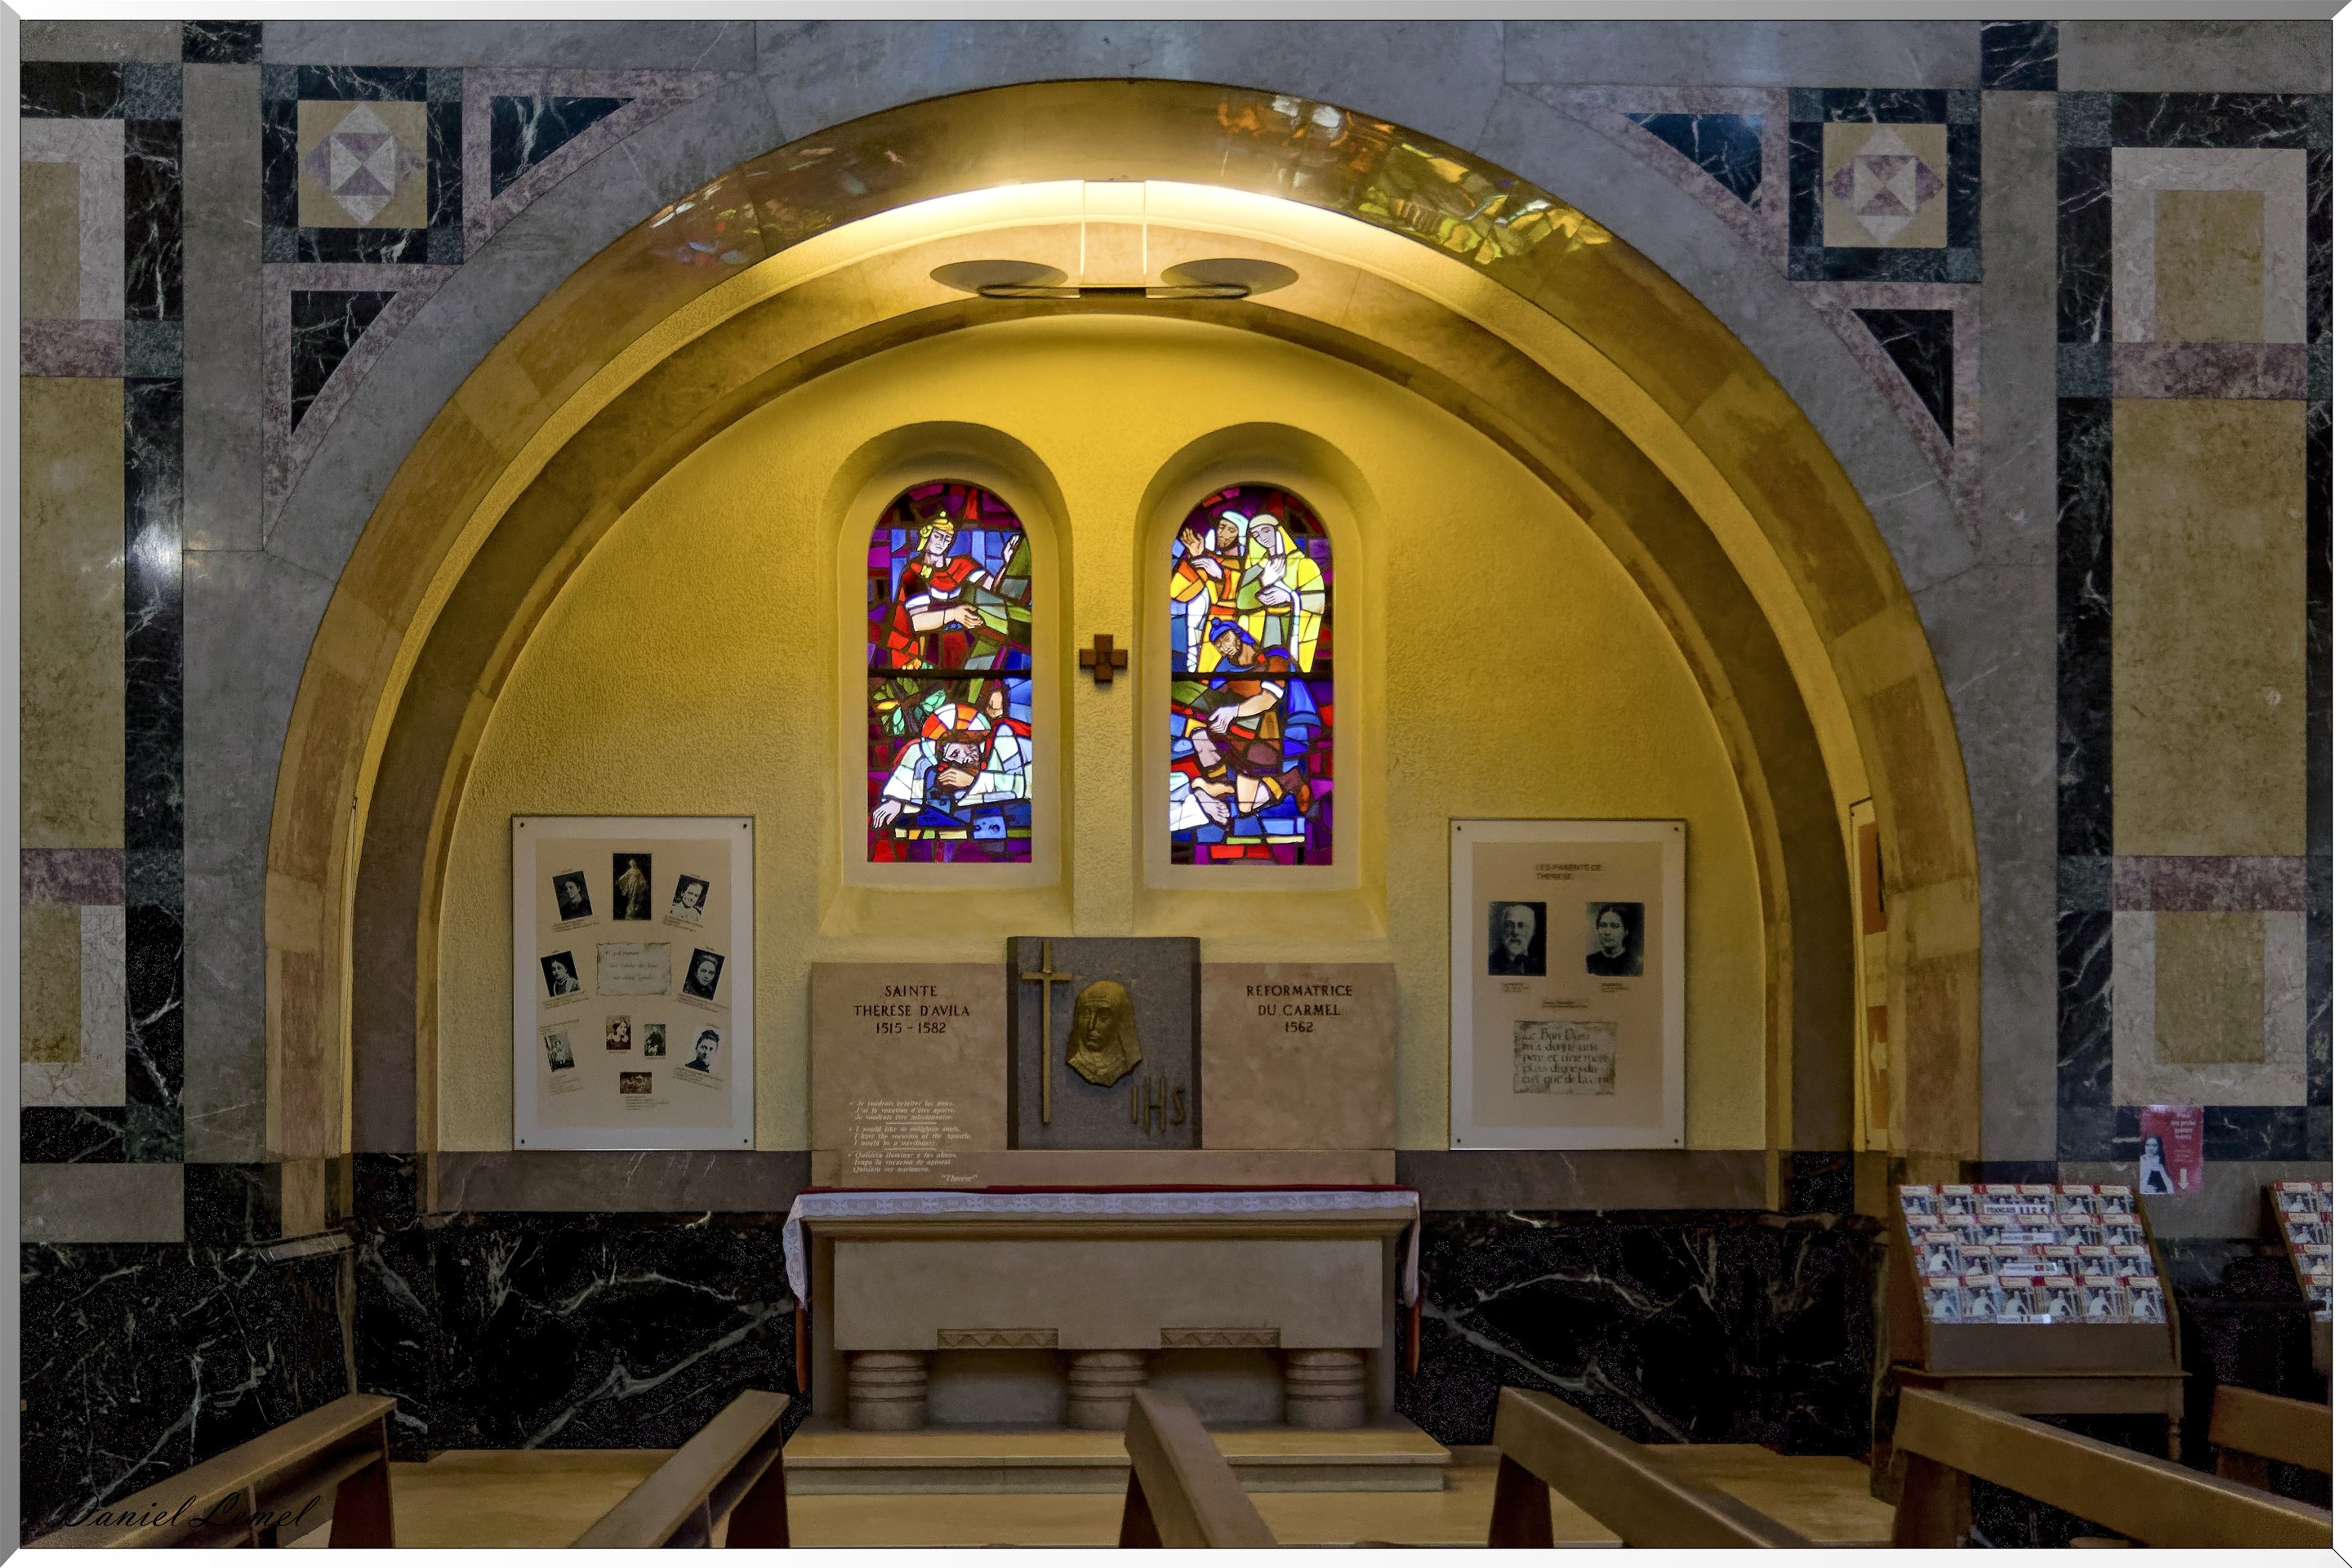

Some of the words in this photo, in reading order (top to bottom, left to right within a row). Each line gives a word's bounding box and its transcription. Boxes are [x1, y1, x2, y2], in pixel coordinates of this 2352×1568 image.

[884, 985, 938, 997] SAINTE
[920, 1004, 970, 1016] D'AVILA
[1258, 1004, 1276, 1016] DU
[1282, 1004, 1341, 1016] CARMEL
[875, 1022, 902, 1034] 1515
[918, 1022, 947, 1034] 1582
[1285, 1021, 1314, 1033] 1562
[1130, 1076, 1187, 1137] IHS
